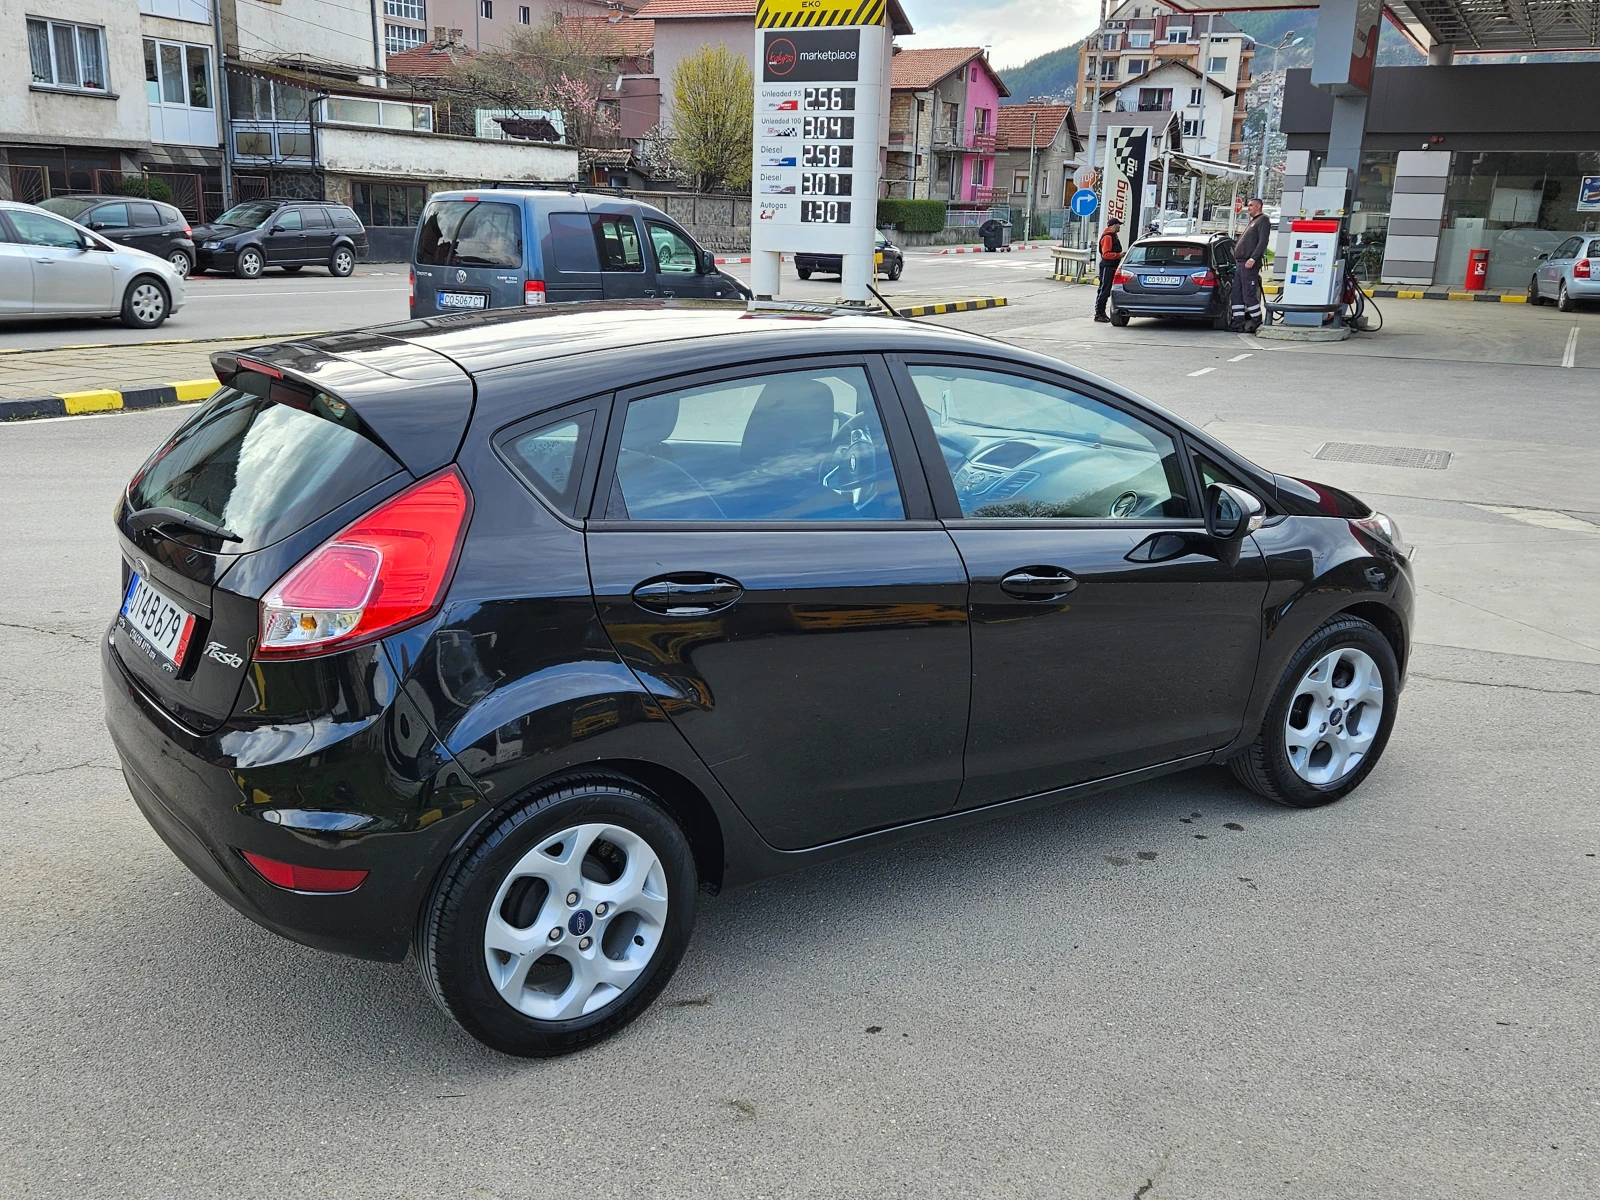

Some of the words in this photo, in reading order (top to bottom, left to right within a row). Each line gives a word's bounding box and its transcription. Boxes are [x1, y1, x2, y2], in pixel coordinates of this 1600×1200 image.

[800, 49, 856, 61] marketplace
[804, 88, 841, 110] 2.56
[804, 117, 841, 138] 3.04
[803, 145, 840, 167] 2.58
[760, 173, 782, 181] Diesel
[1126, 157, 1135, 178] 100
[803, 173, 839, 195] 3.07
[760, 201, 787, 211] Autogas
[1114, 179, 1129, 220] acing
[808, 201, 838, 223] 1.30
[203, 641, 243, 668] Fiesta
